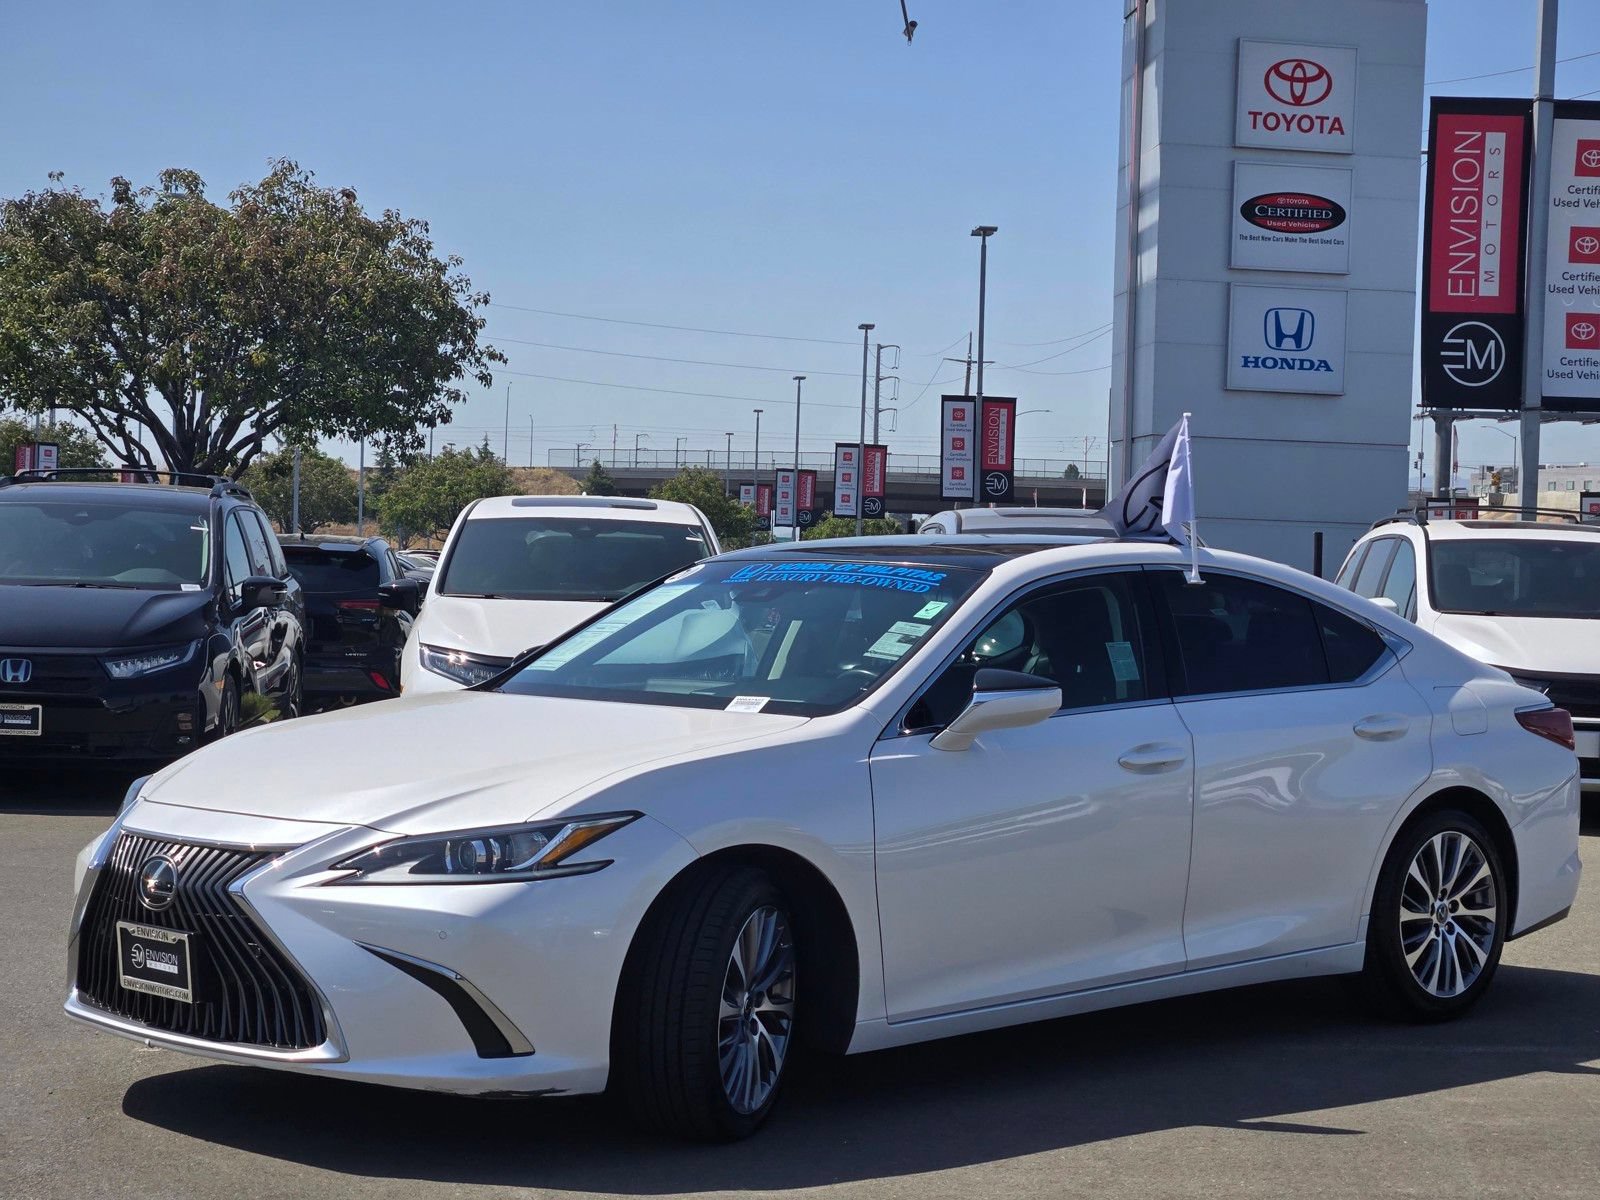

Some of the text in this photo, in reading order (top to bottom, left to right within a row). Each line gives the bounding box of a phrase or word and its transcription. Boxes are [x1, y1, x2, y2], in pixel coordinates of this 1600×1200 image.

[1248, 111, 1345, 135] TOYOTA
[1553, 197, 1580, 208] Used
[1447, 131, 1482, 297] ENVISION
[1484, 147, 1501, 283] MOTORS
[1288, 221, 1320, 229] Vehicles
[1548, 284, 1575, 294] Used
[1241, 356, 1334, 372] HONDA
[1560, 356, 1600, 367] Certifie
[1547, 369, 1600, 380] Used Vehi
[988, 407, 1000, 465] ENVISION
[865, 451, 875, 492] ENVISION
[773, 563, 947, 581] HONDA OF MILPITAS
[755, 573, 931, 593] LUXURY PRE-OWNED
[137, 926, 169, 941] ENVISION
[145, 948, 178, 966] ENVISION
[123, 978, 190, 1000] ENVISIONMOTORS.COM
